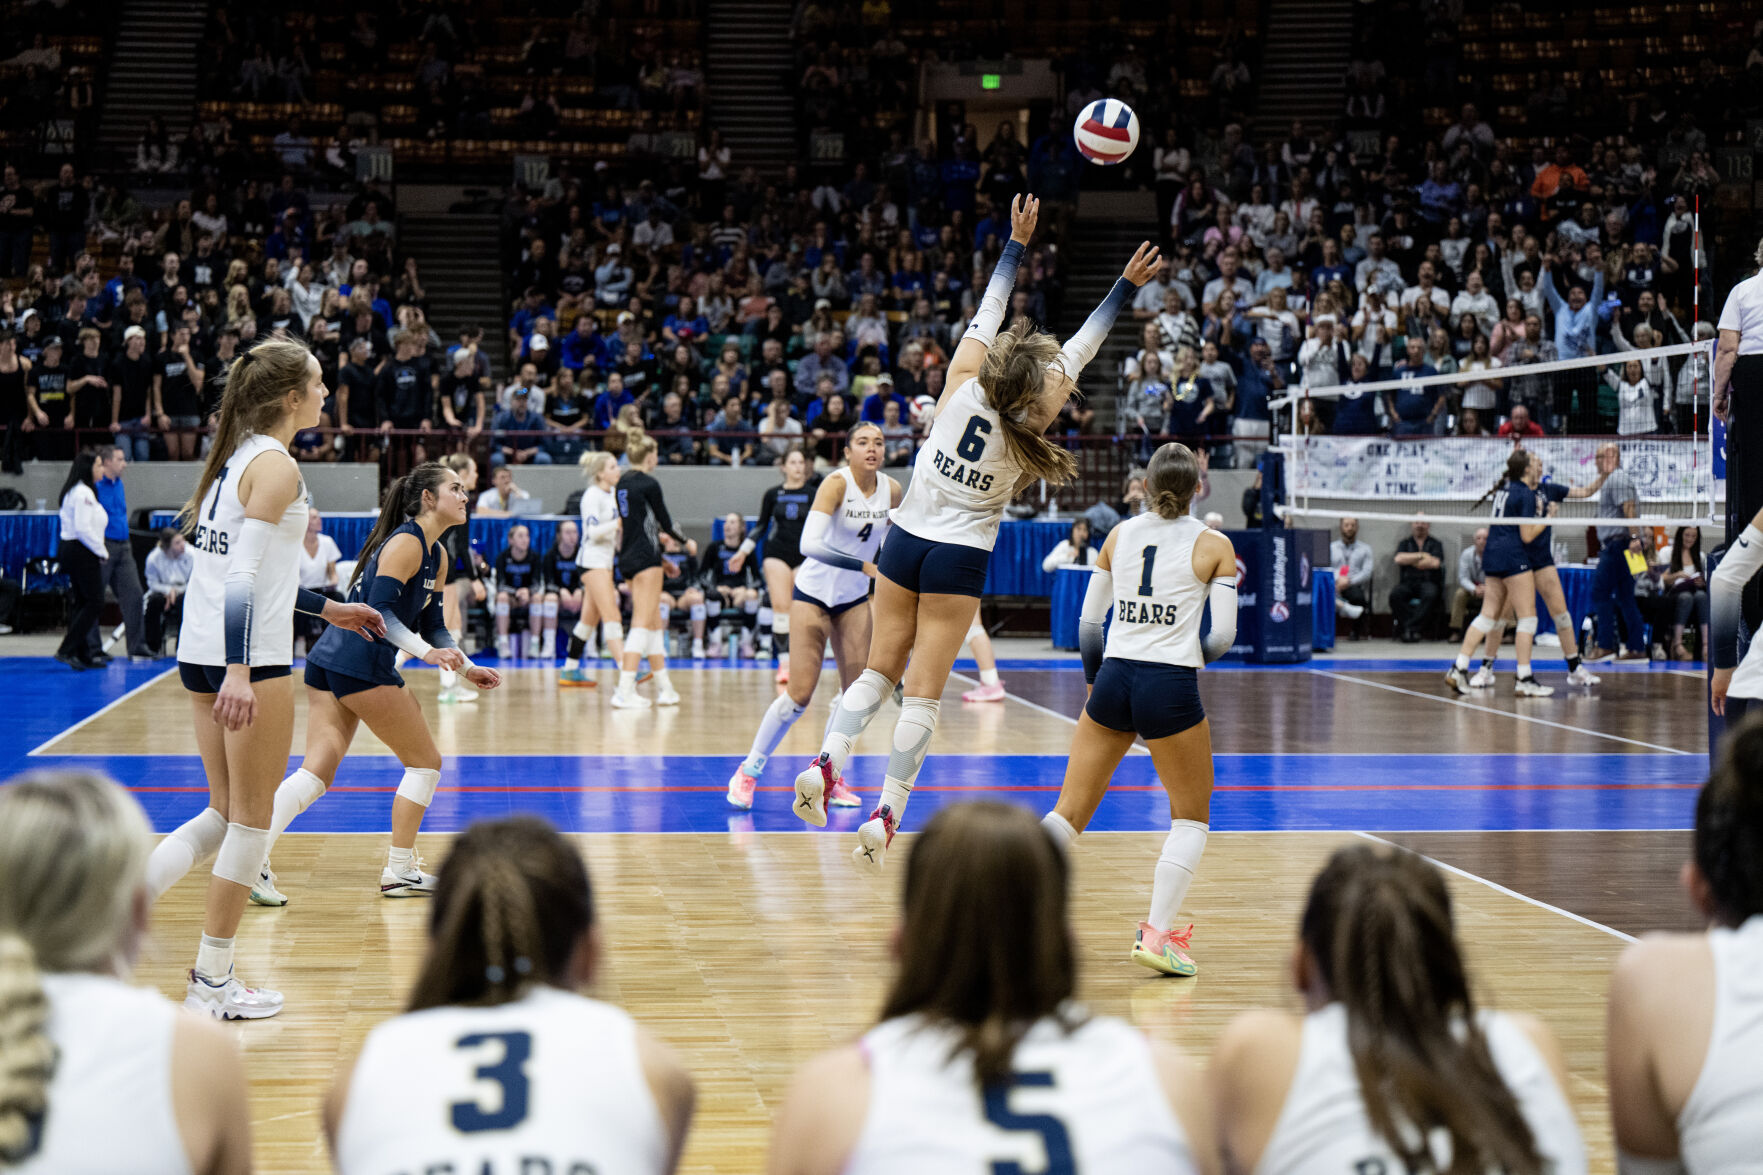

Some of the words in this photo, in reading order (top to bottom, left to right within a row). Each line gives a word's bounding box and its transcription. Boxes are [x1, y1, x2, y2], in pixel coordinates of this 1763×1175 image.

[1727, 155, 1752, 177] 113
[956, 414, 992, 462] 6
[846, 509, 871, 519] PALMER
[857, 522, 874, 542] 4
[1138, 545, 1158, 597] 1
[1118, 600, 1177, 626] BEARS
[451, 1030, 533, 1135] 3
[983, 1070, 1077, 1175] 5
